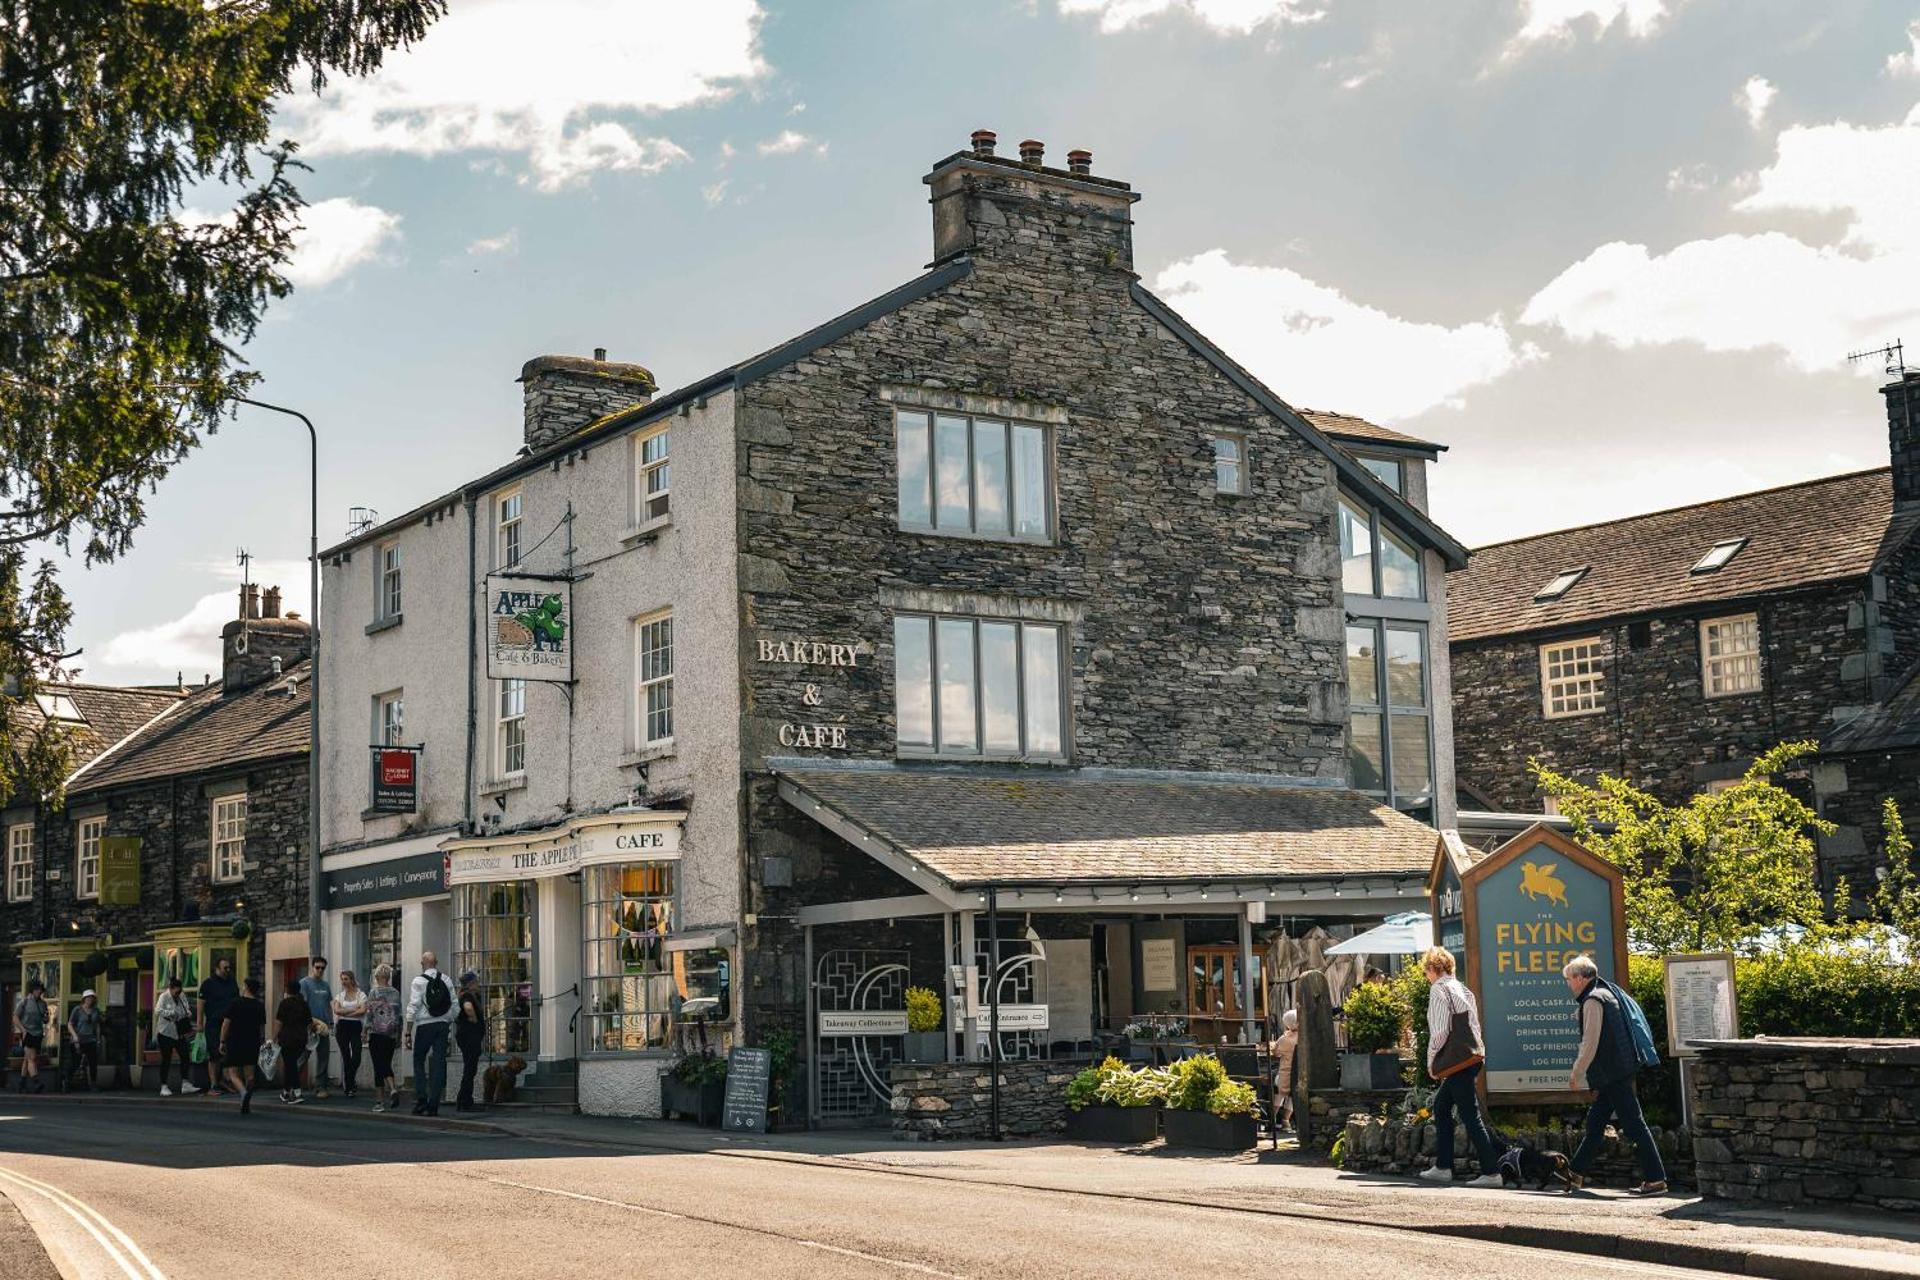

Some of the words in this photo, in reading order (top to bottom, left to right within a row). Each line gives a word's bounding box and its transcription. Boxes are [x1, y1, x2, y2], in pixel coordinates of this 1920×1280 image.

[493, 591, 543, 614] APPLE
[534, 627, 563, 652] PIE
[533, 652, 564, 666] Bakery
[757, 639, 859, 667] BAKERY
[803, 683, 822, 706] &
[779, 714, 847, 749] CAFÉ
[616, 833, 663, 850] CAFE
[512, 851, 537, 869] THE
[541, 848, 568, 866] APPLE
[344, 881, 362, 894] Property
[403, 870, 437, 884] Conveyancing
[1496, 921, 1596, 945] FLYING
[1497, 950, 1596, 973] FLEEC
[858, 1019, 891, 1027] Collection
[1533, 1058, 1549, 1066] LOG
[1551, 1075, 1568, 1083] HOU
